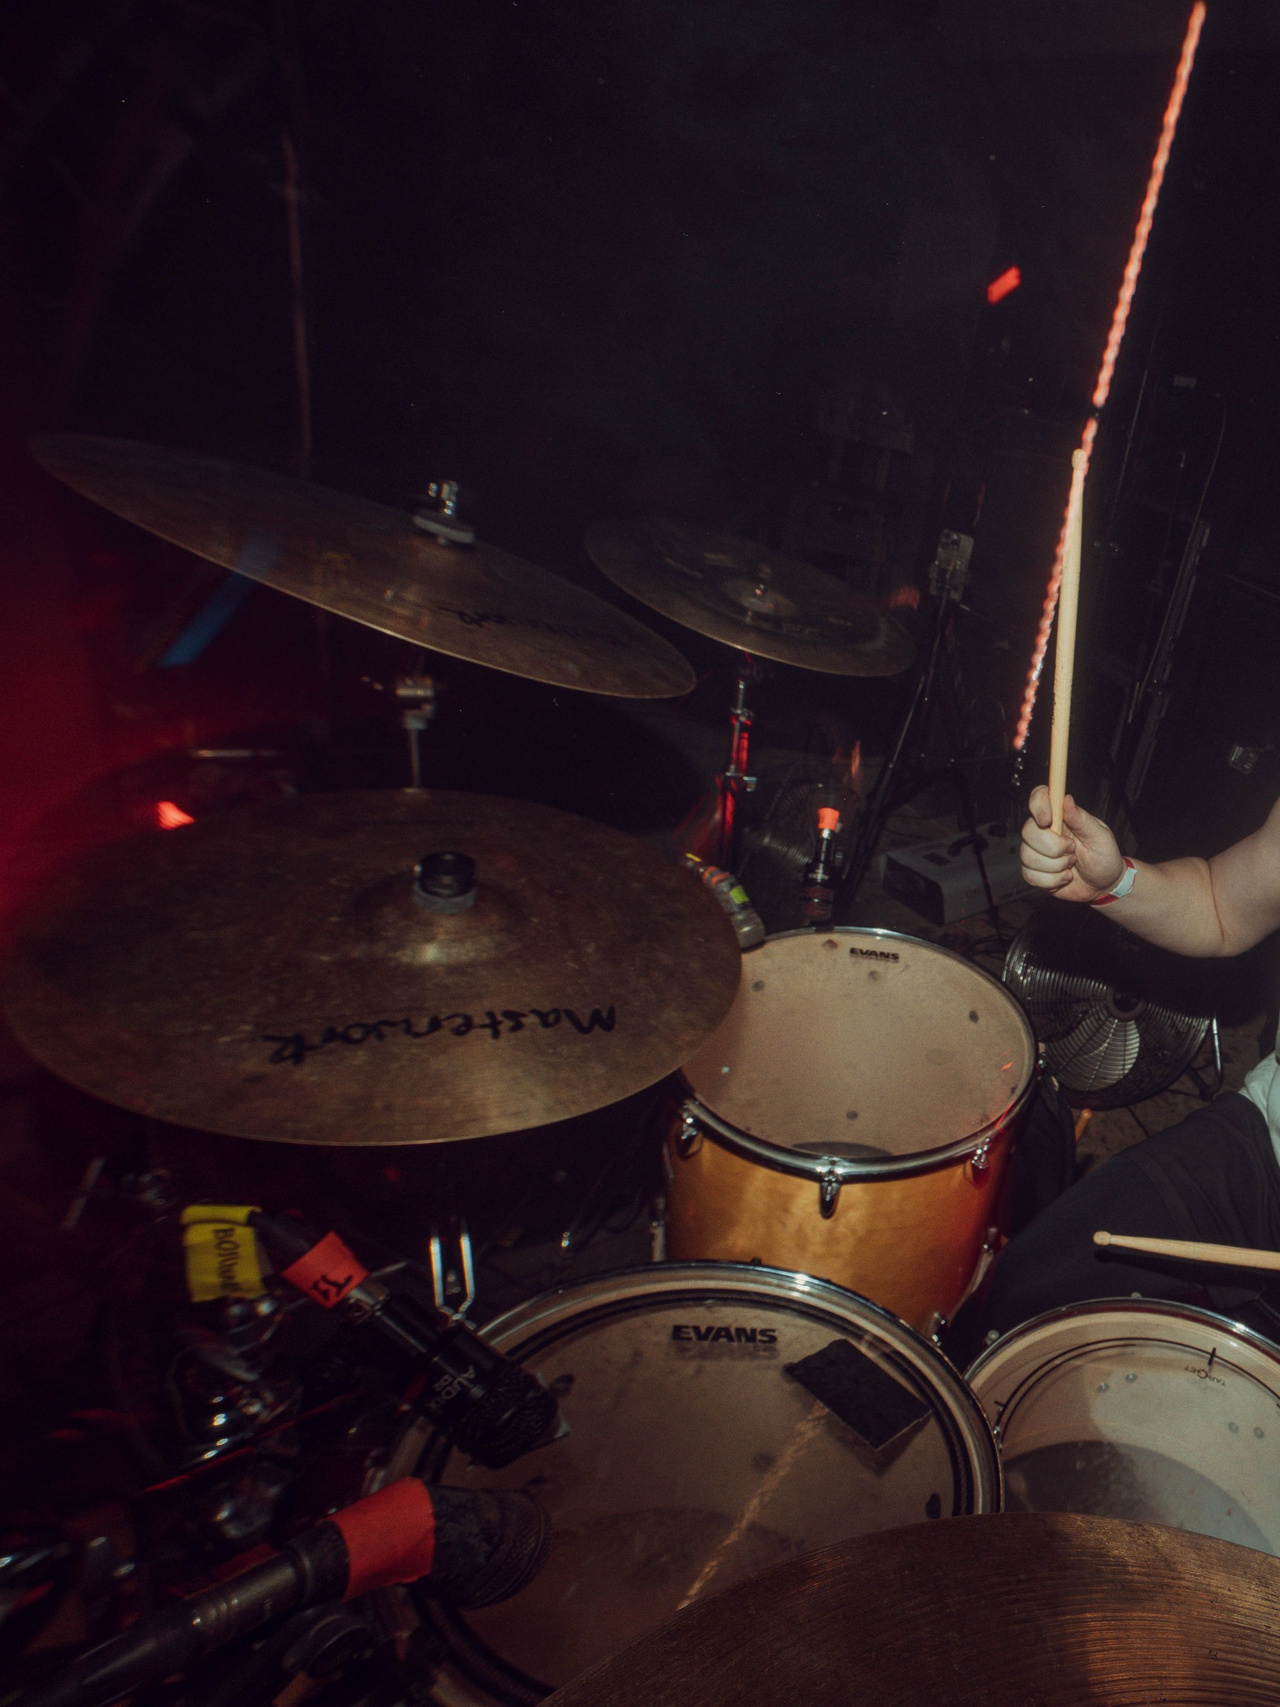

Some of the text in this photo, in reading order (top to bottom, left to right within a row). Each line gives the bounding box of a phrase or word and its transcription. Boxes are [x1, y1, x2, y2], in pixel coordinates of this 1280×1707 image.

[850, 947, 900, 960] EVANS
[261, 1004, 617, 1065] Masterwork
[672, 1324, 778, 1344] EVANS
[423, 1364, 477, 1414] AUDIX
